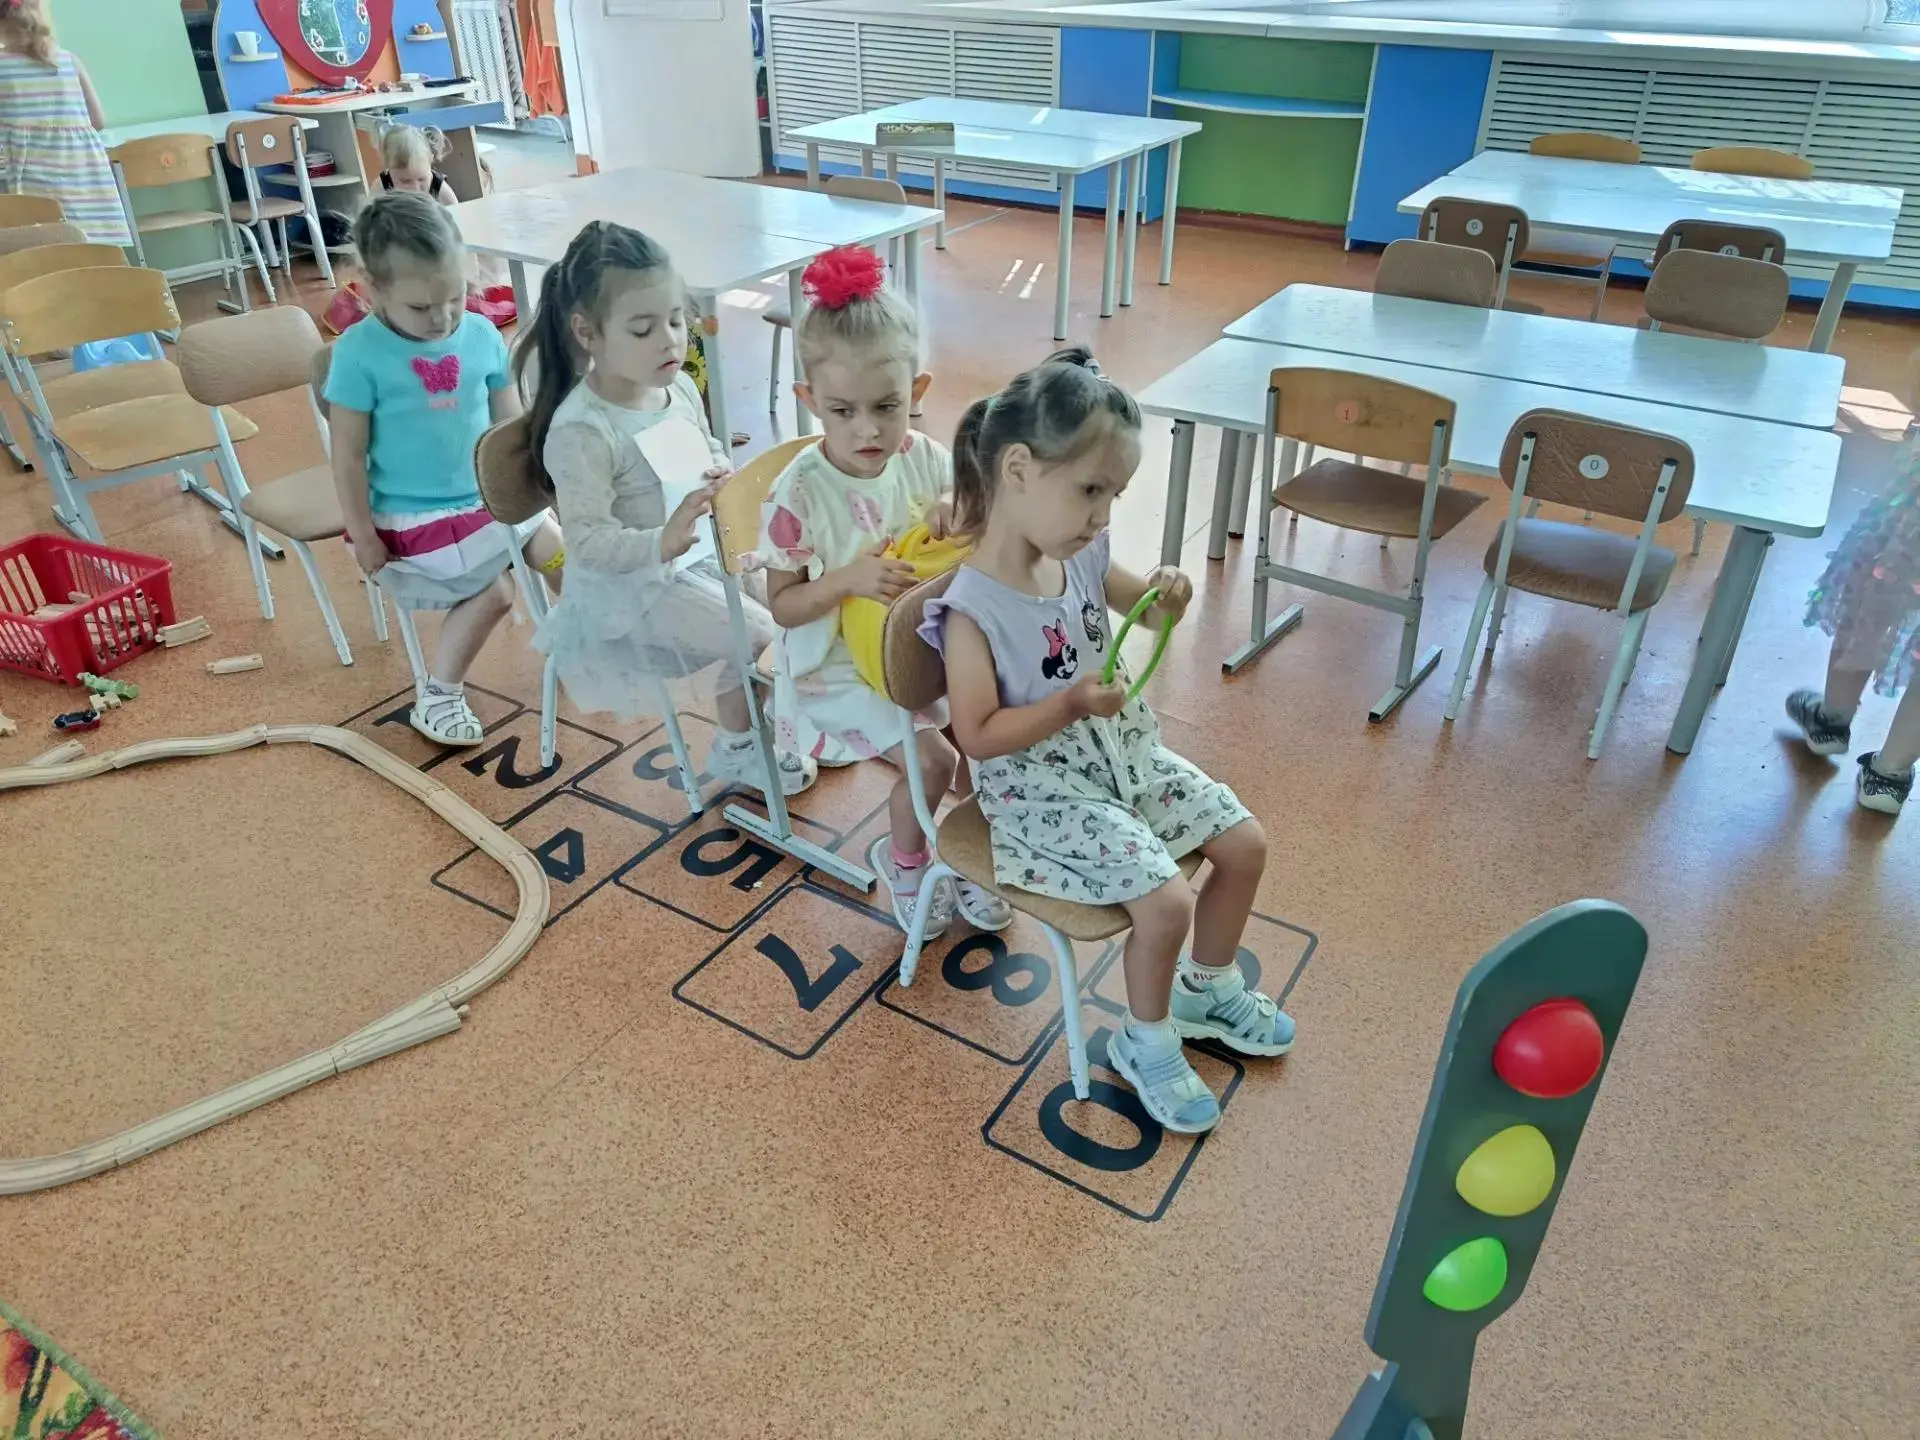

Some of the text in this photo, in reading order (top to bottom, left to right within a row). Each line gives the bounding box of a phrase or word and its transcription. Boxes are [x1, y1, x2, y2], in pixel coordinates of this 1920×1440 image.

[1590, 459, 1600, 471] 0
[460, 735, 563, 789] 2
[533, 827, 586, 885] 4
[680, 828, 787, 893] 5
[755, 933, 863, 1013] 7
[941, 934, 1052, 1007] 8
